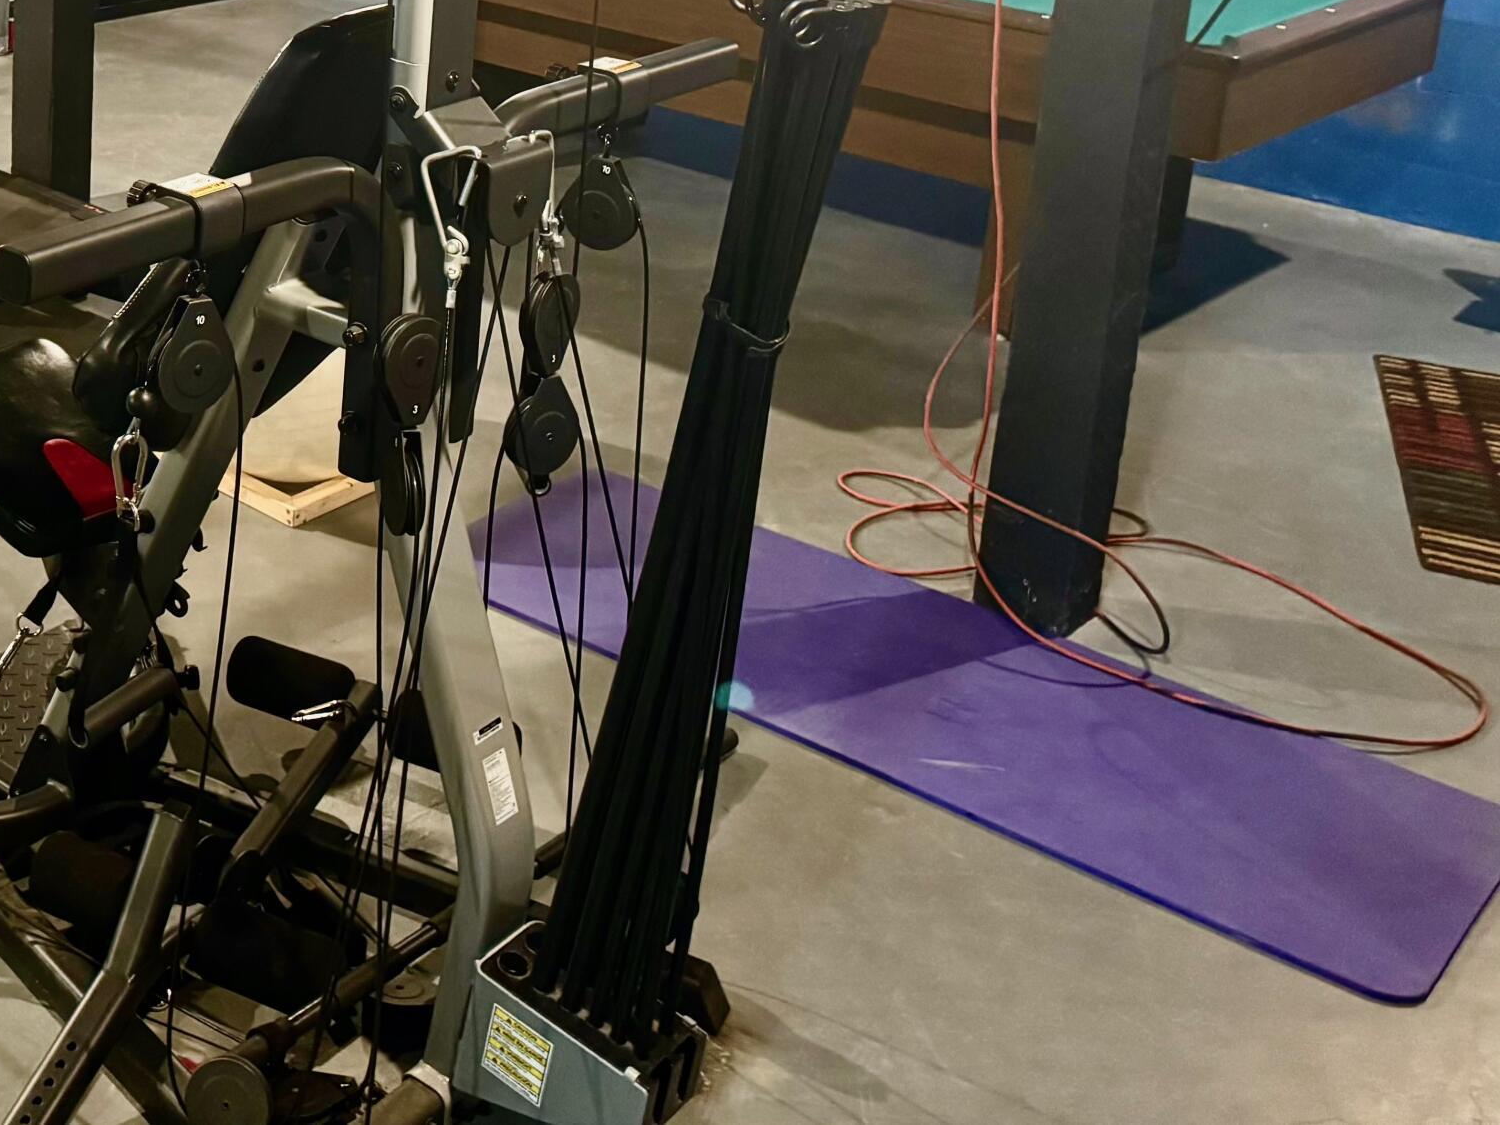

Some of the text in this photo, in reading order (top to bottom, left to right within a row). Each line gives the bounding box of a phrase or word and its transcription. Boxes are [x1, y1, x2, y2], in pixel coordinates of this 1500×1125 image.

[602, 165, 611, 174] 10
[196, 315, 205, 325] 10
[412, 404, 419, 414] 3
